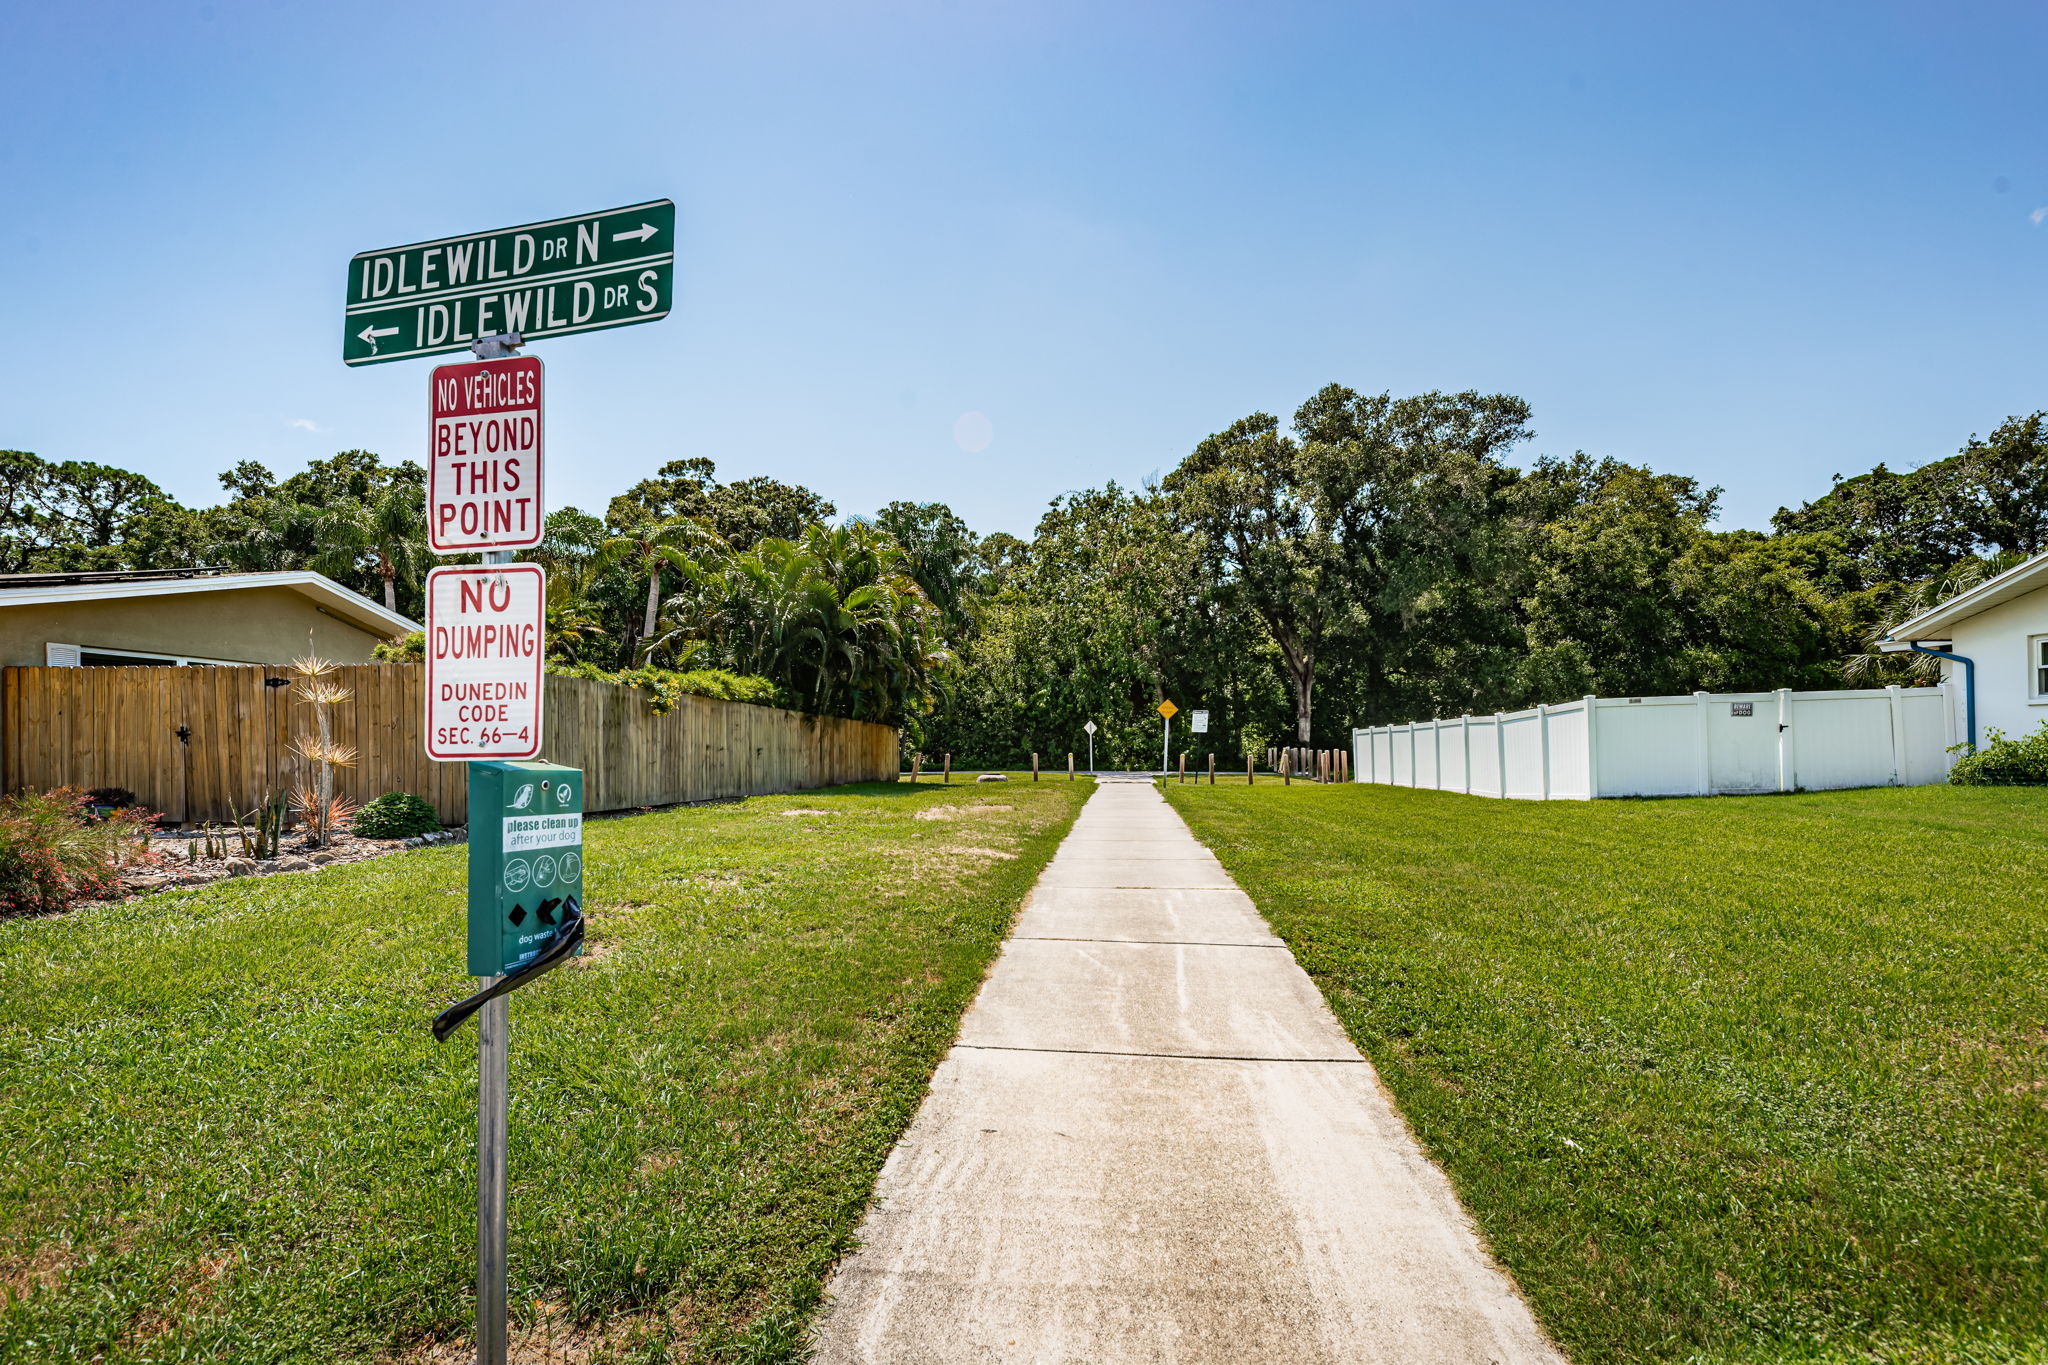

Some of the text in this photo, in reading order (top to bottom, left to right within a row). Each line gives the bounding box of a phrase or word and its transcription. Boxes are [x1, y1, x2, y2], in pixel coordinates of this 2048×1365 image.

[361, 221, 600, 299] IDLEWILD DR N
[417, 270, 658, 347] IDLEWILD DR S
[438, 370, 535, 412] NO VEHICLES
[438, 417, 534, 457] BEYOND
[451, 458, 520, 496] THIS
[440, 498, 531, 537] POINT
[460, 579, 511, 614] NO
[436, 623, 535, 660] DUMPING
[441, 682, 527, 702] DUNEDIN
[458, 704, 509, 722] CODE
[437, 727, 474, 745] SEC.
[507, 817, 579, 833] please clean up
[511, 830, 576, 846] after your dog
[518, 934, 533, 944] dog
[534, 930, 553, 941] waste
